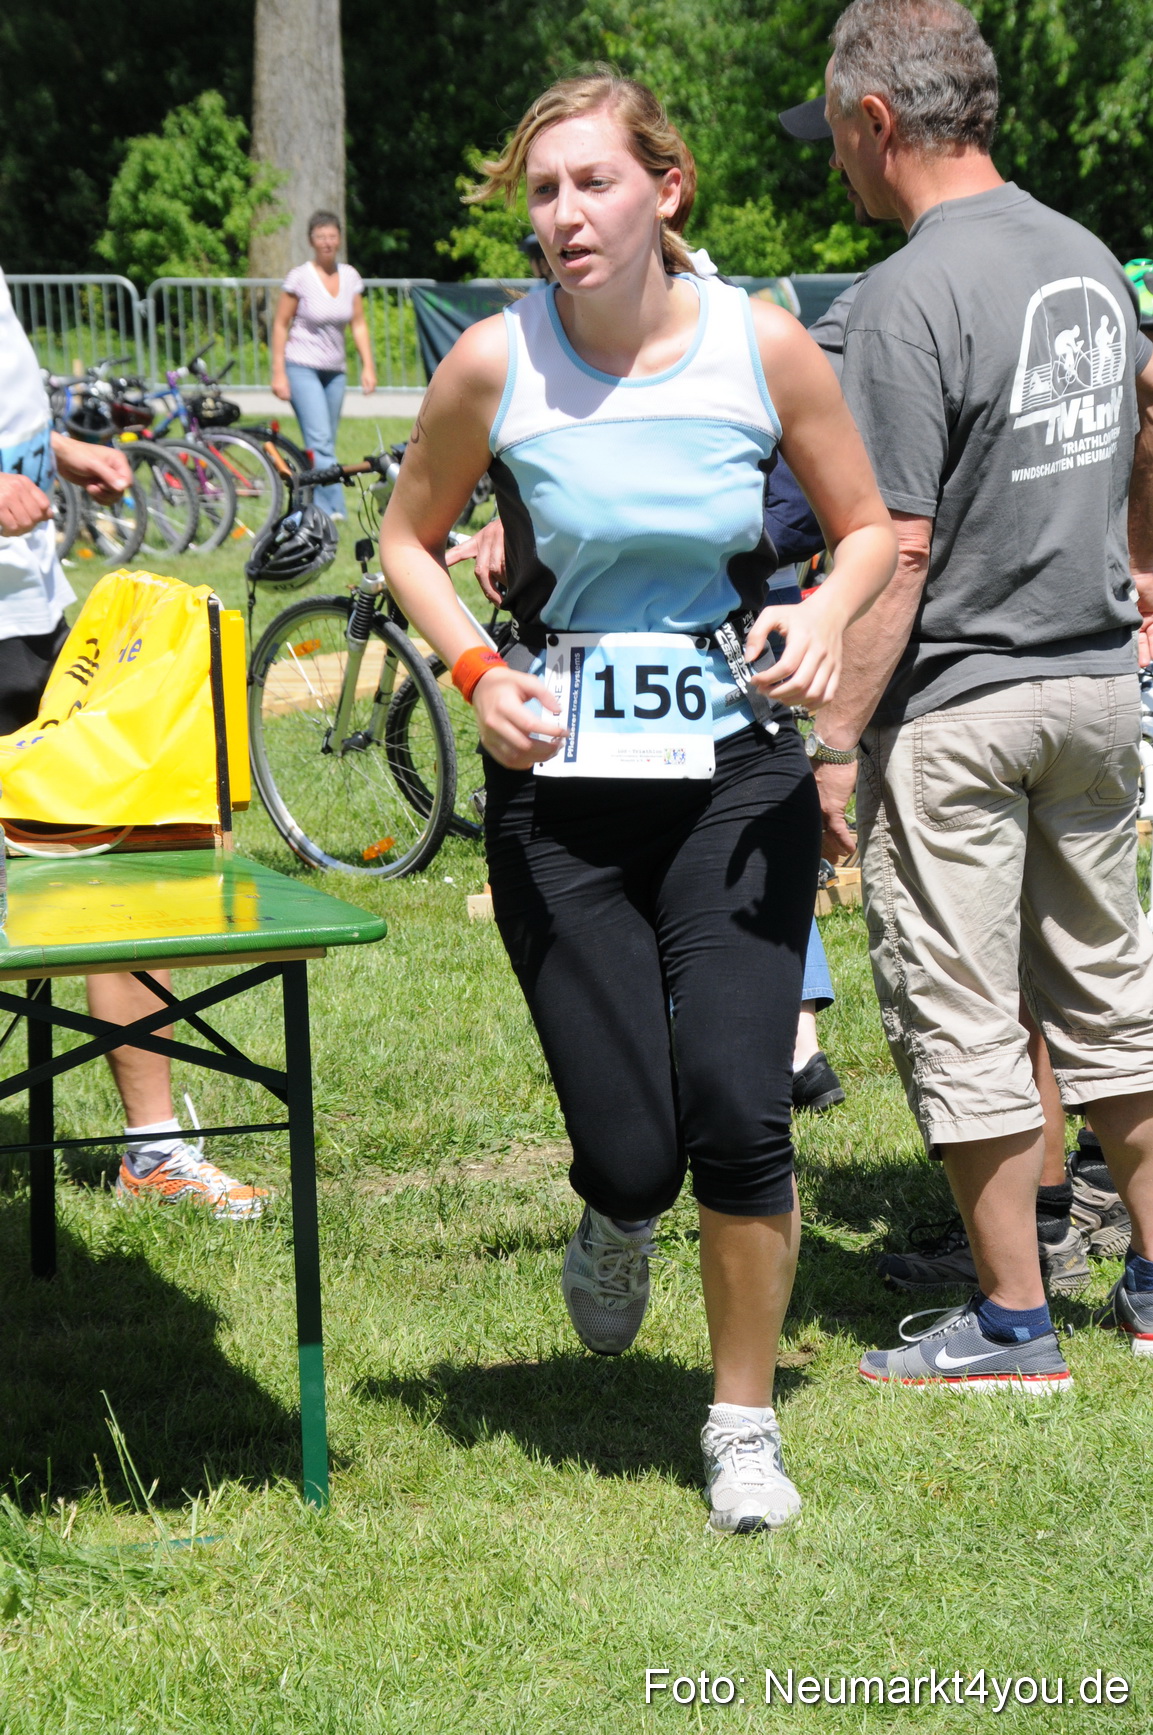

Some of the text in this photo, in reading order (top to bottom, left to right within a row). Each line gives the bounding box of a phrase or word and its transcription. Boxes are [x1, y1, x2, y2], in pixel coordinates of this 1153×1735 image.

[1011, 456, 1074, 482] WINDSCHATTEN
[571, 689, 579, 712] track
[594, 664, 707, 721] 156
[567, 714, 577, 758] Pfleiderer
